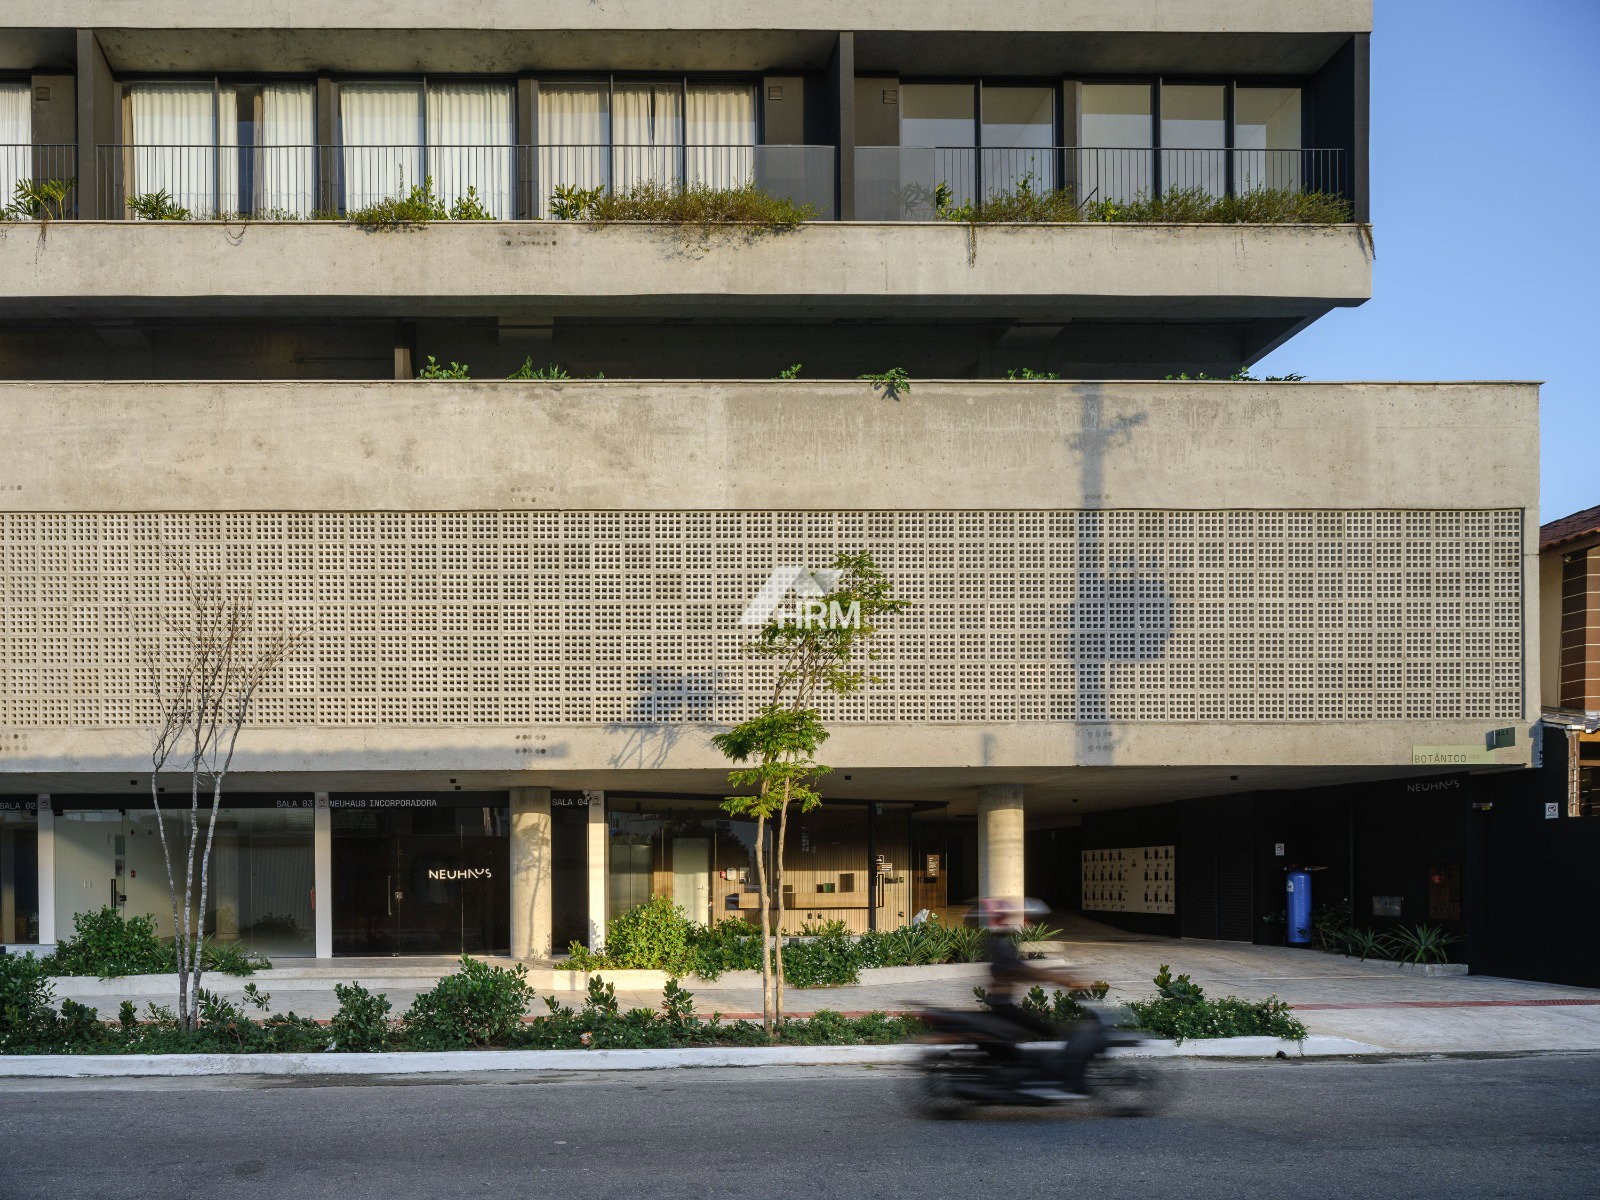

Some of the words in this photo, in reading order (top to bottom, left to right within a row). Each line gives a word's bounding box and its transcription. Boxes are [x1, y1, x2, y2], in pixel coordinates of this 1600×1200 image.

[1414, 752, 1467, 764] BOTÂNICO
[0, 802, 21, 810] SALA
[25, 801, 36, 810] 02
[276, 800, 297, 808] SALA
[329, 799, 366, 808] NEUHAUS
[369, 799, 438, 807] INCORPORADORA
[552, 798, 573, 806] SALA
[577, 798, 589, 806] 04
